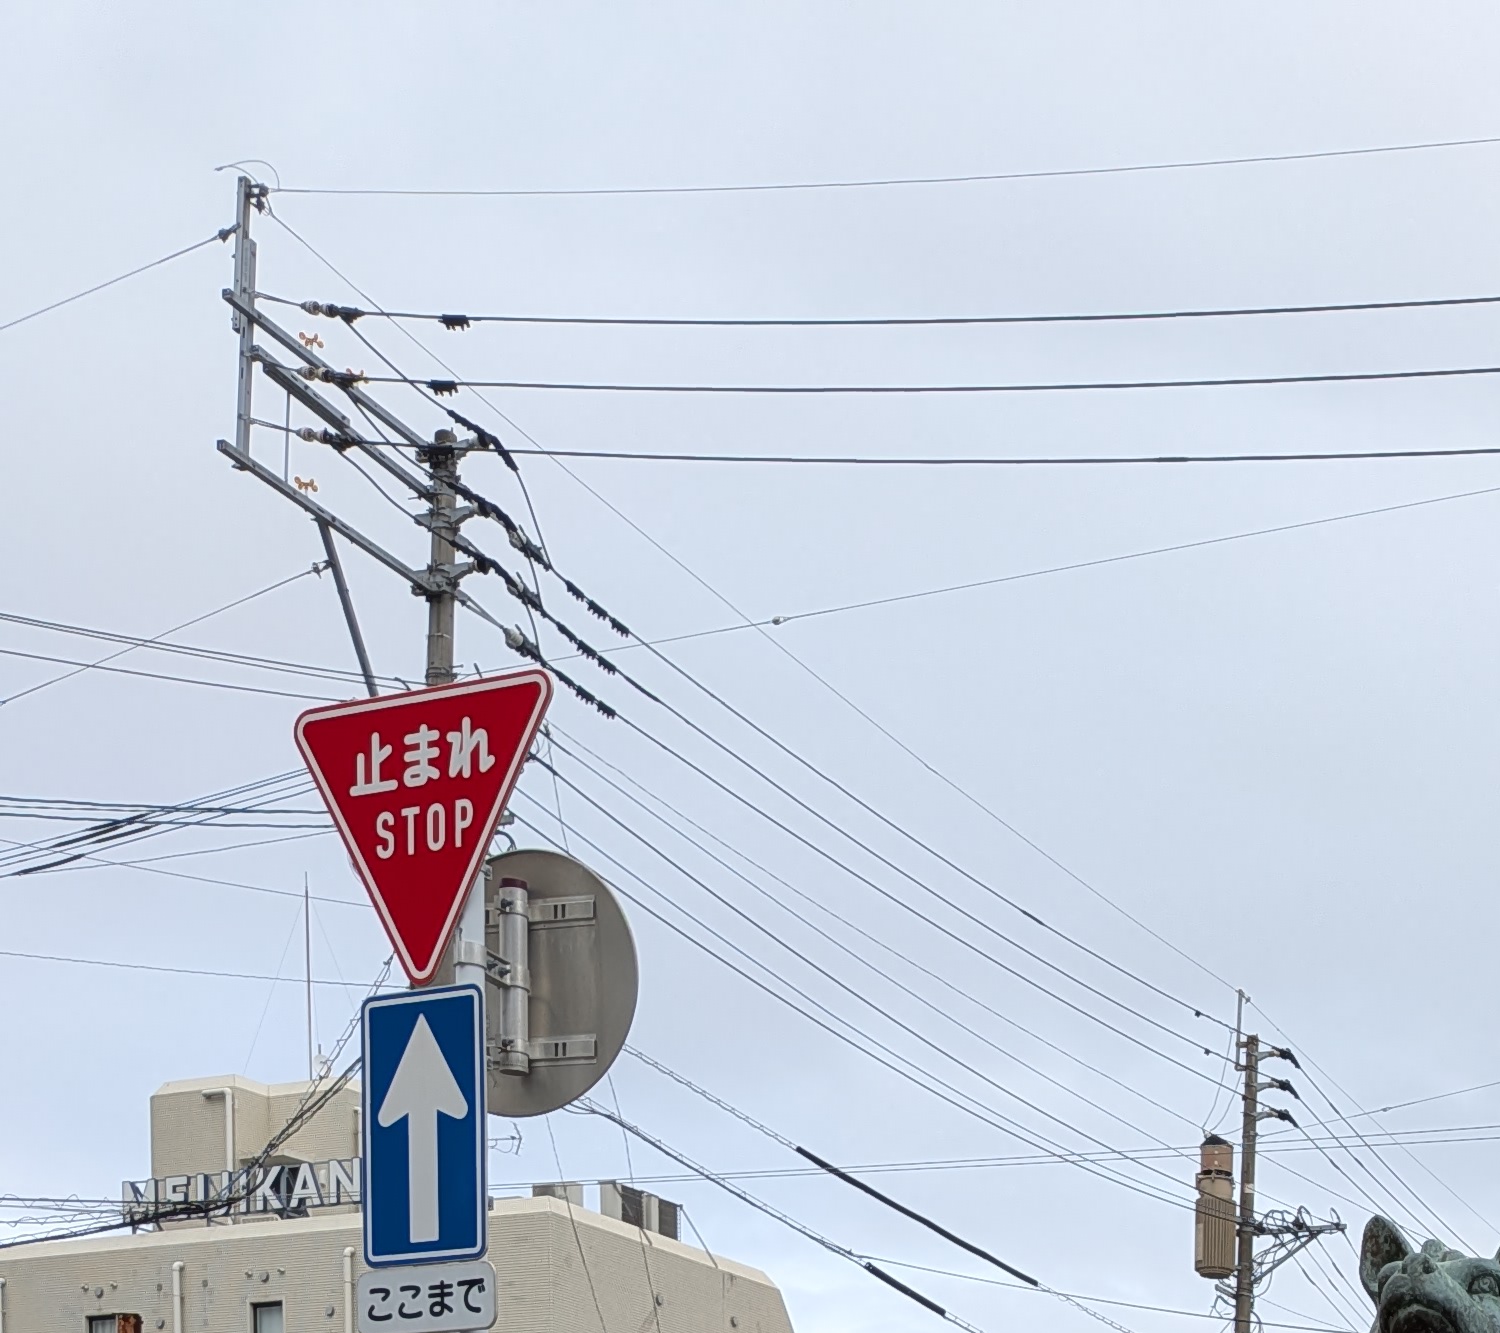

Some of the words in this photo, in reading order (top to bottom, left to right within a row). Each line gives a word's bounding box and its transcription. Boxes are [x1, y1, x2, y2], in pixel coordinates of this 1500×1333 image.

[350, 716, 495, 797] 止まれ
[376, 798, 474, 859] STOP
[368, 1278, 485, 1321] ここまで
